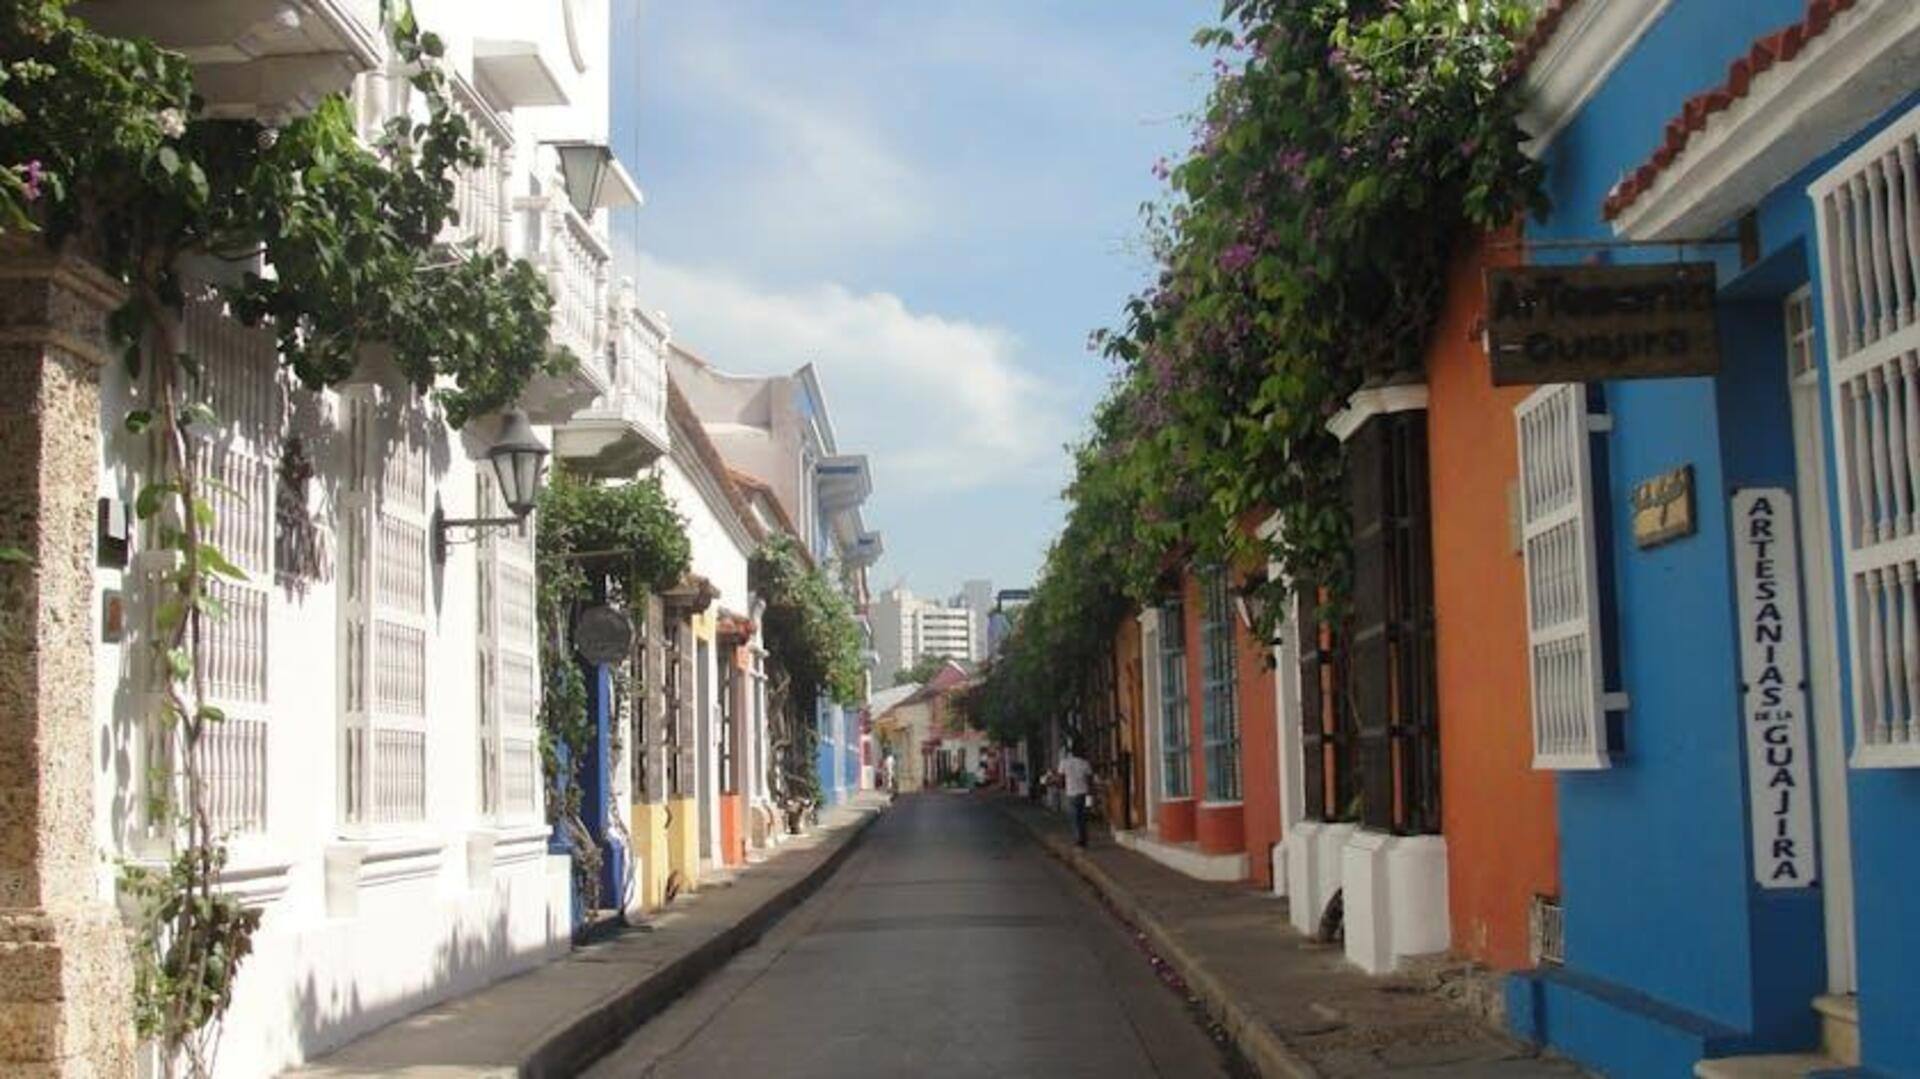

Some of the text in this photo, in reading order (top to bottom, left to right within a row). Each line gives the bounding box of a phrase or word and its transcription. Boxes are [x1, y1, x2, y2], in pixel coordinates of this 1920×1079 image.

[1748, 497, 1783, 707] ARTESANIAS
[1754, 710, 1770, 722] DE
[1763, 724, 1798, 879] GUAJIRA
